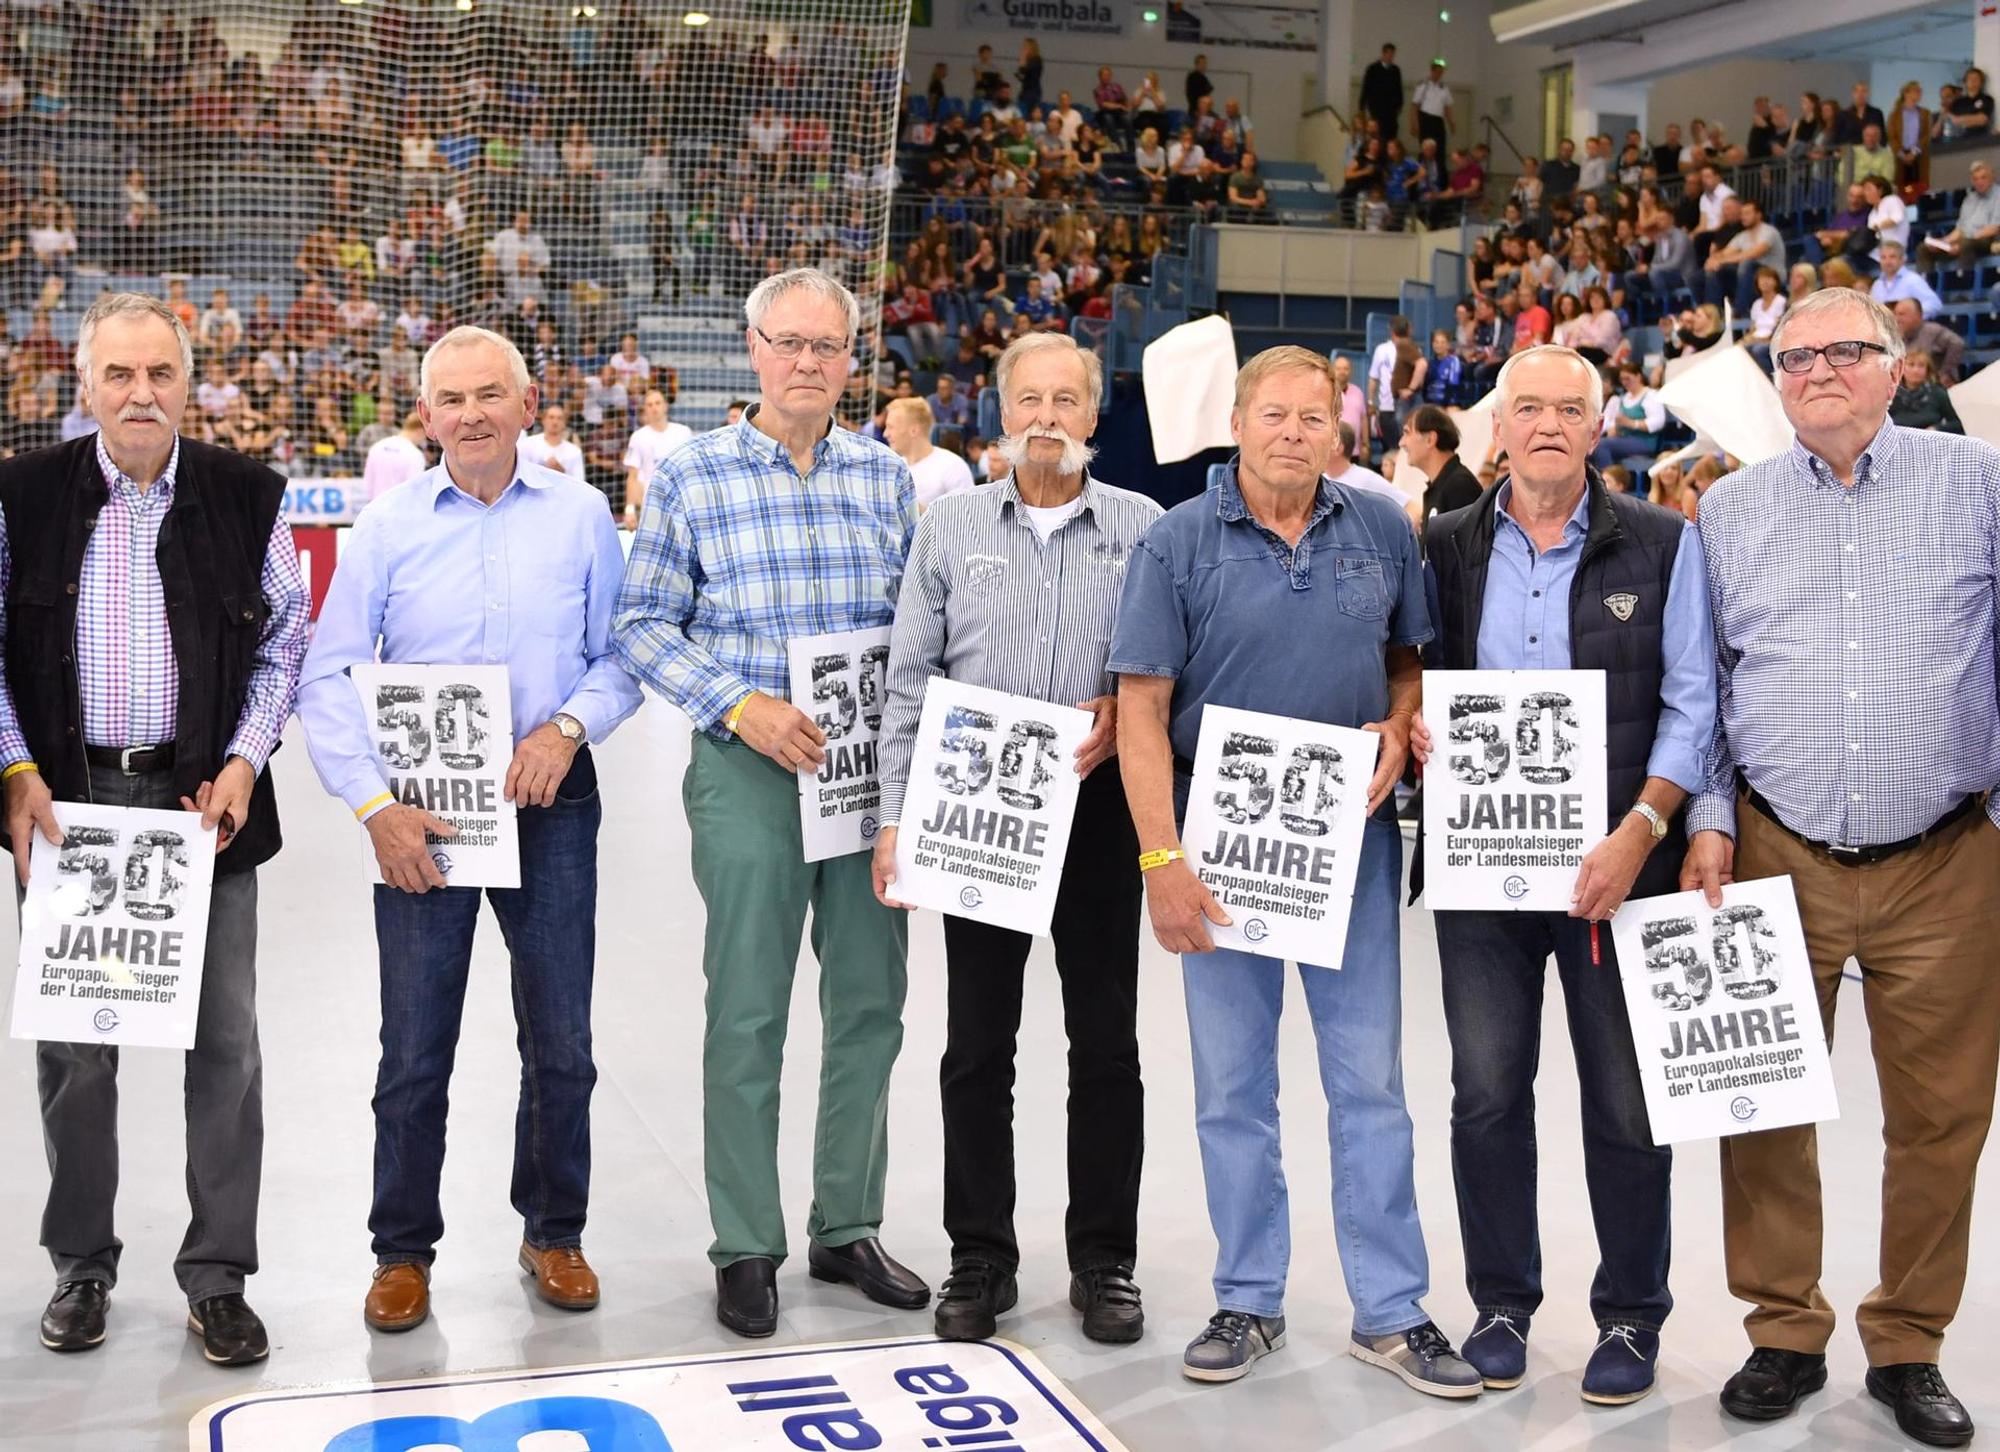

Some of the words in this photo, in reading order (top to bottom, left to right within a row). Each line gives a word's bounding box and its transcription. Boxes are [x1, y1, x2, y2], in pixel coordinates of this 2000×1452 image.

[1003, 0, 1112, 21] Gumbala
[812, 645, 891, 739] 50
[377, 683, 490, 770] 50
[1449, 692, 1583, 785] 50
[818, 740, 878, 784] JAH
[934, 704, 1060, 811] 50
[1213, 731, 1346, 836] 50
[439, 816, 497, 832] alsieger
[820, 804, 837, 818] der
[922, 800, 1049, 857] JAHRE
[1447, 793, 1583, 830] JAHRE
[917, 835, 1040, 876] Europapokalsieger
[1202, 830, 1336, 885] JAHRE
[1447, 835, 1583, 852] Europapokalsieger
[1447, 852, 1472, 867] der
[1478, 852, 1583, 867] Landesmeister
[55, 825, 190, 921] 50
[914, 852, 938, 867] der
[941, 857, 1037, 891] Landesmeister
[1198, 868, 1329, 904] Europapokalsieger
[1223, 890, 1325, 920] Landesmeister
[45, 924, 183, 967] JAHRE
[1641, 904, 1783, 1011] 50
[40, 982, 65, 996] der
[70, 983, 176, 1003] Landesmeister
[42, 963, 179, 988] Europaposieger
[1660, 1004, 1800, 1060] JAHRE
[1664, 1047, 1803, 1080] Europapokalsieger
[1668, 1082, 1693, 1097] der
[1698, 1064, 1806, 1093] Landesmeister
